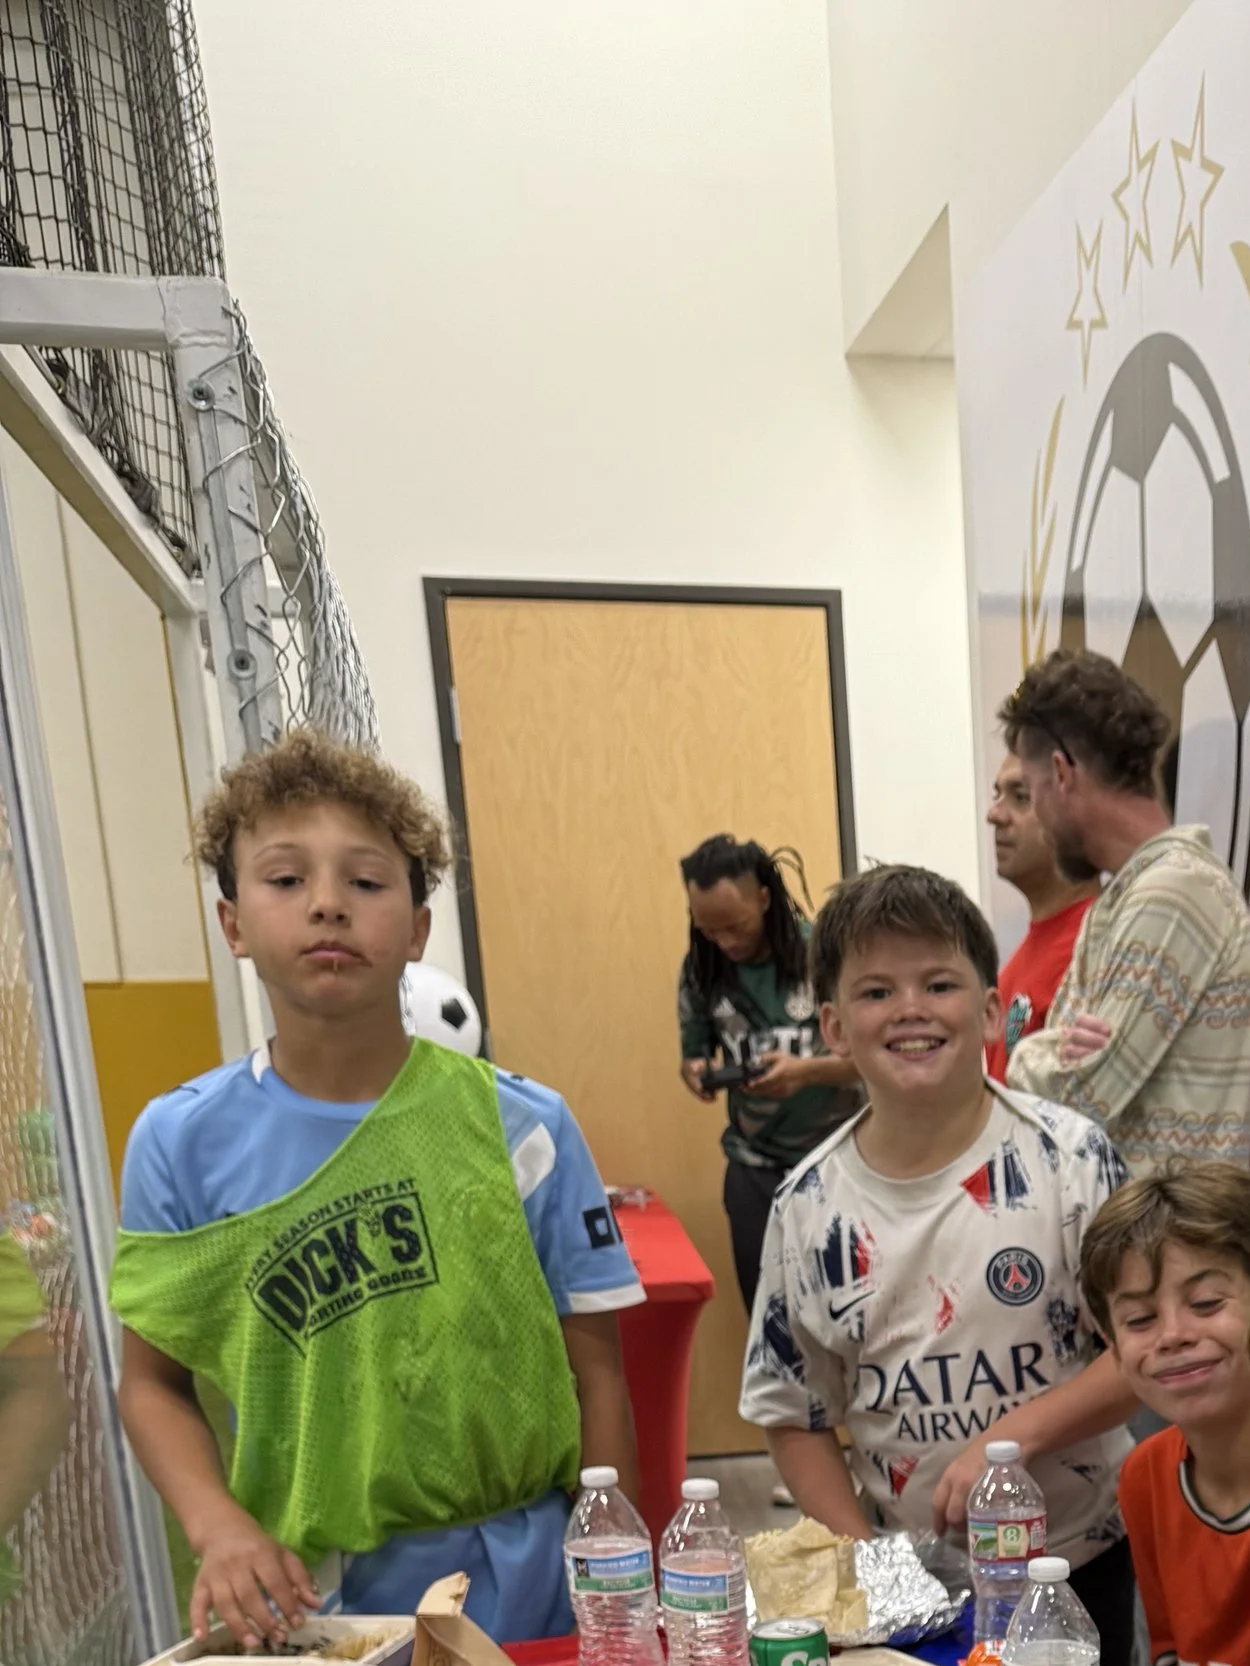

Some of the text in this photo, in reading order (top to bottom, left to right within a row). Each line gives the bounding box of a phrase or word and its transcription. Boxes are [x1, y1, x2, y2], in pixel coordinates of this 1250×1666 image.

[721, 1027, 813, 1066] YTI
[258, 1204, 422, 1331] DICK'S
[854, 1342, 1049, 1415] QATAR
